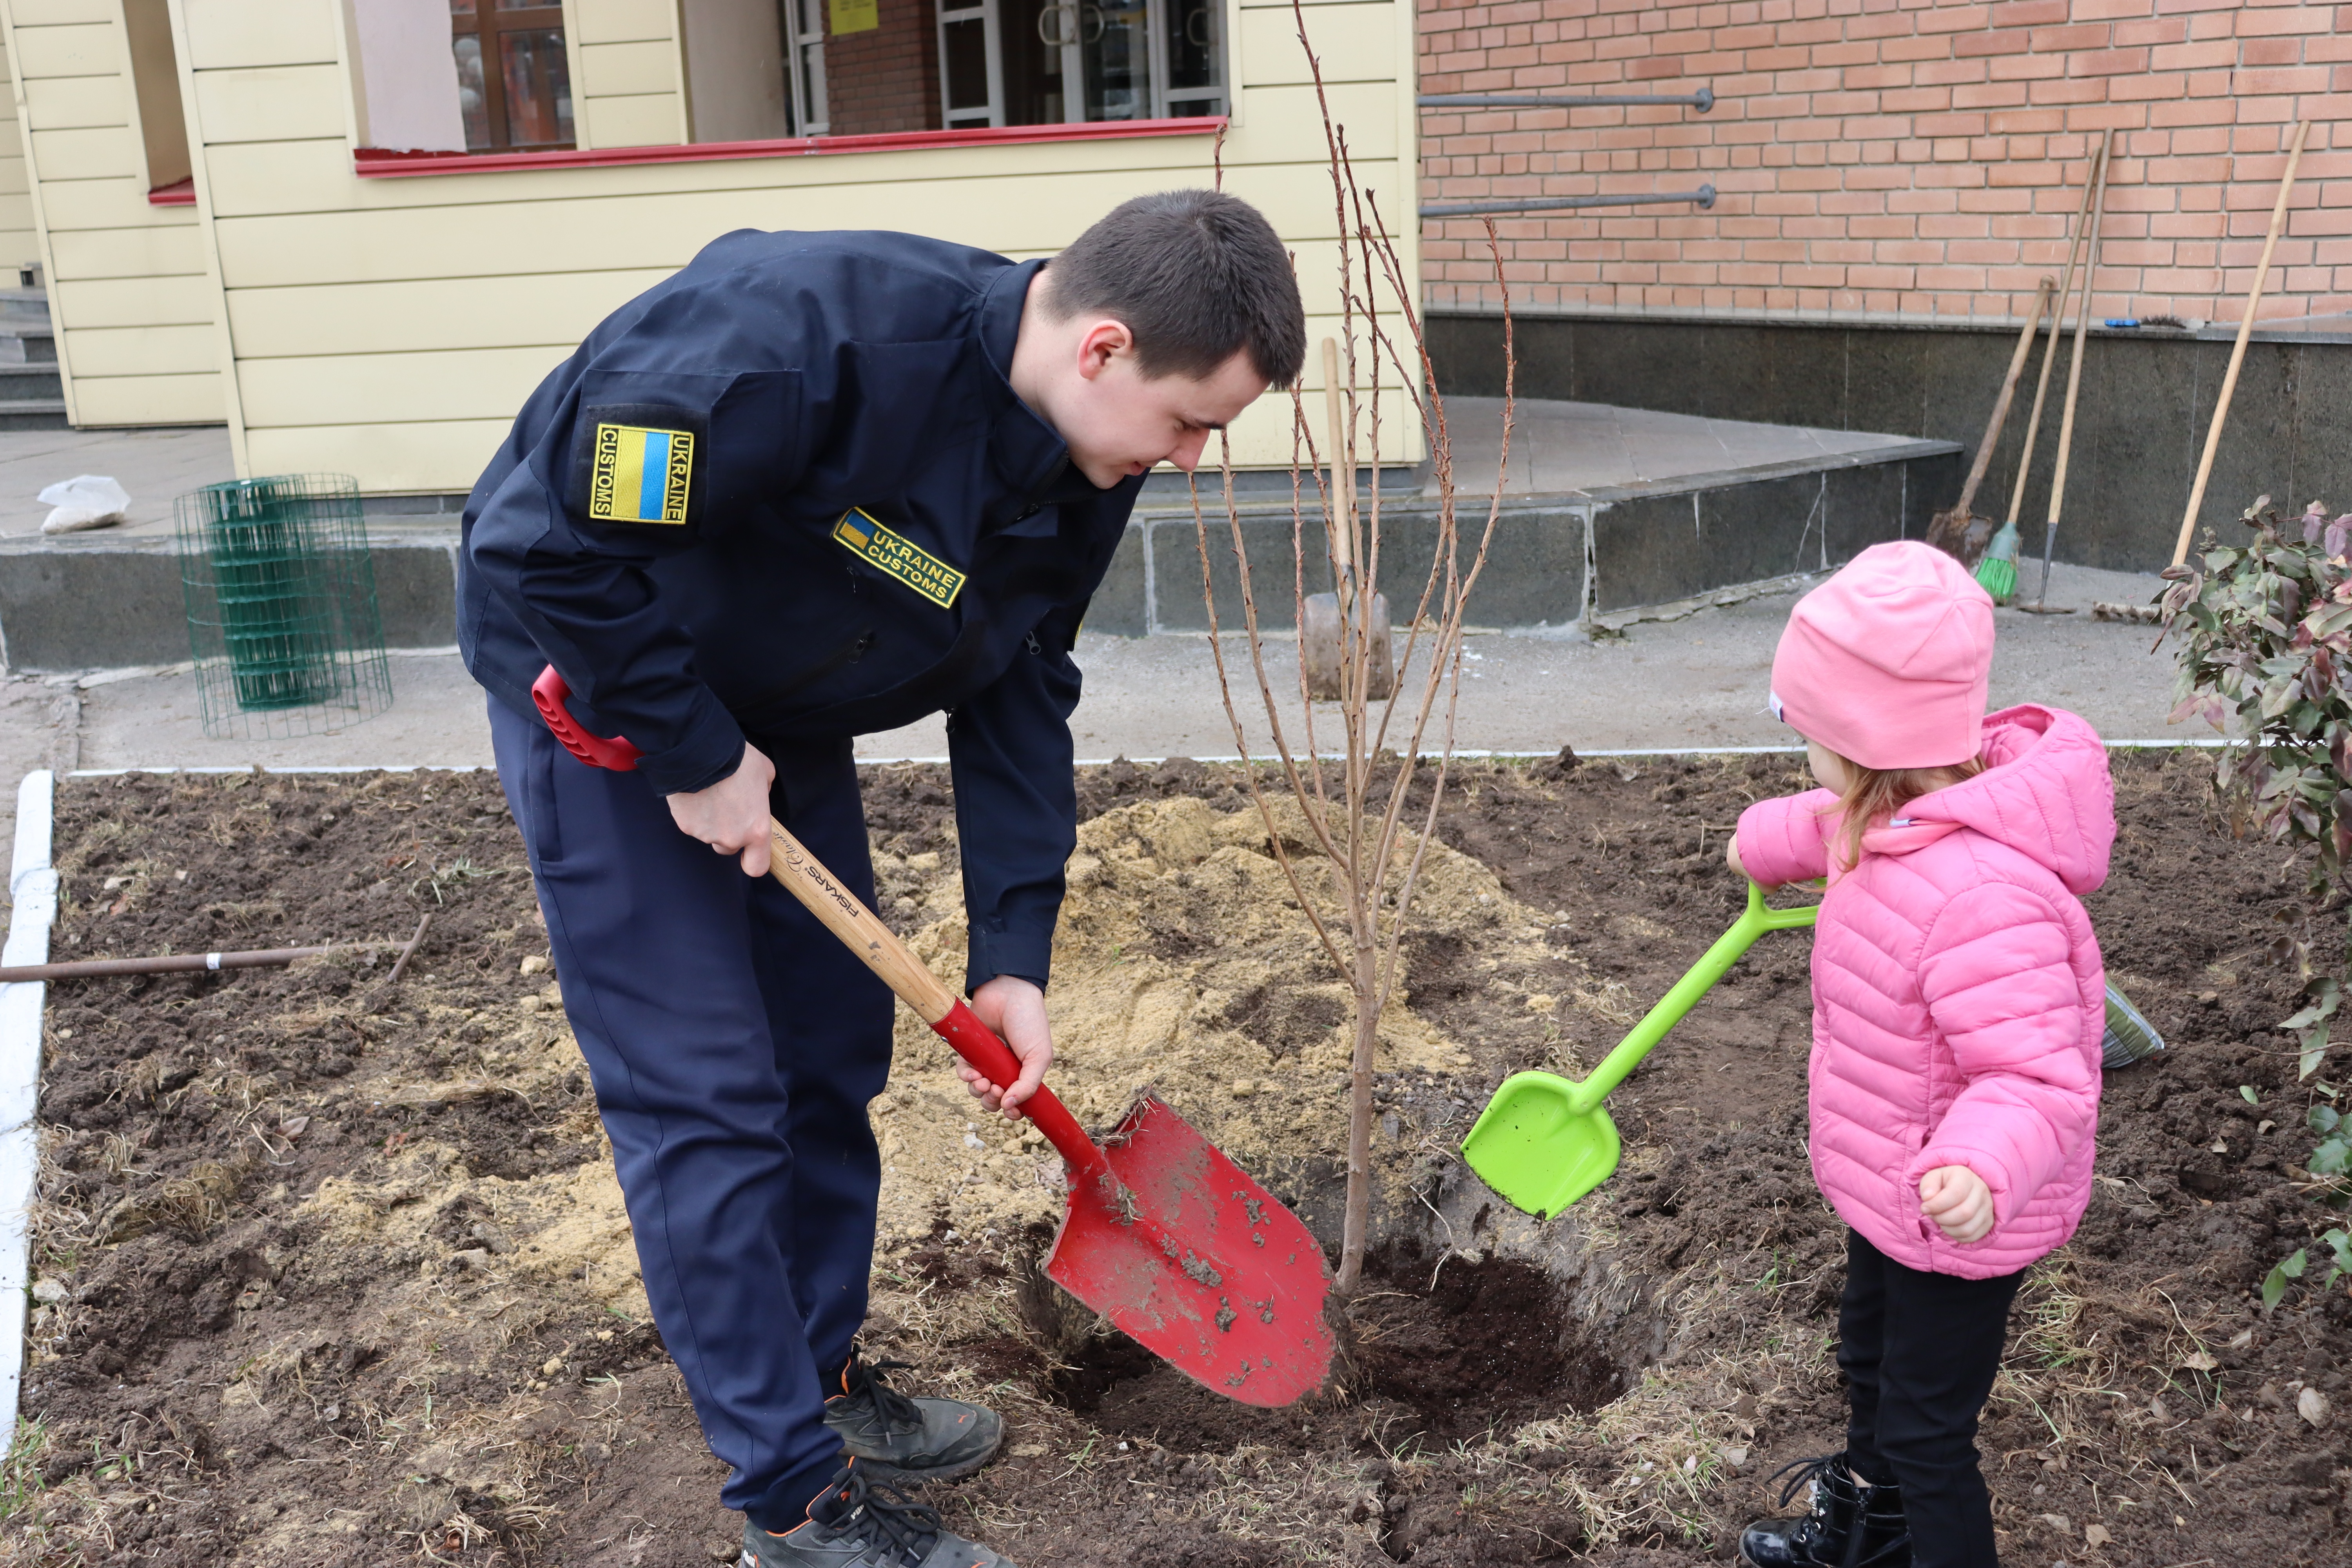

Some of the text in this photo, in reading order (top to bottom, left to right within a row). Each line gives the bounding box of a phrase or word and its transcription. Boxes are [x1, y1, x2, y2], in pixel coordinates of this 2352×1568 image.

[595, 430, 617, 513] CUSTOMS
[666, 437, 690, 519] UKRAINE
[868, 545, 947, 599] CUSTOMS
[873, 531, 956, 588] UKRAINE
[773, 832, 859, 917] FISKARS Classic
